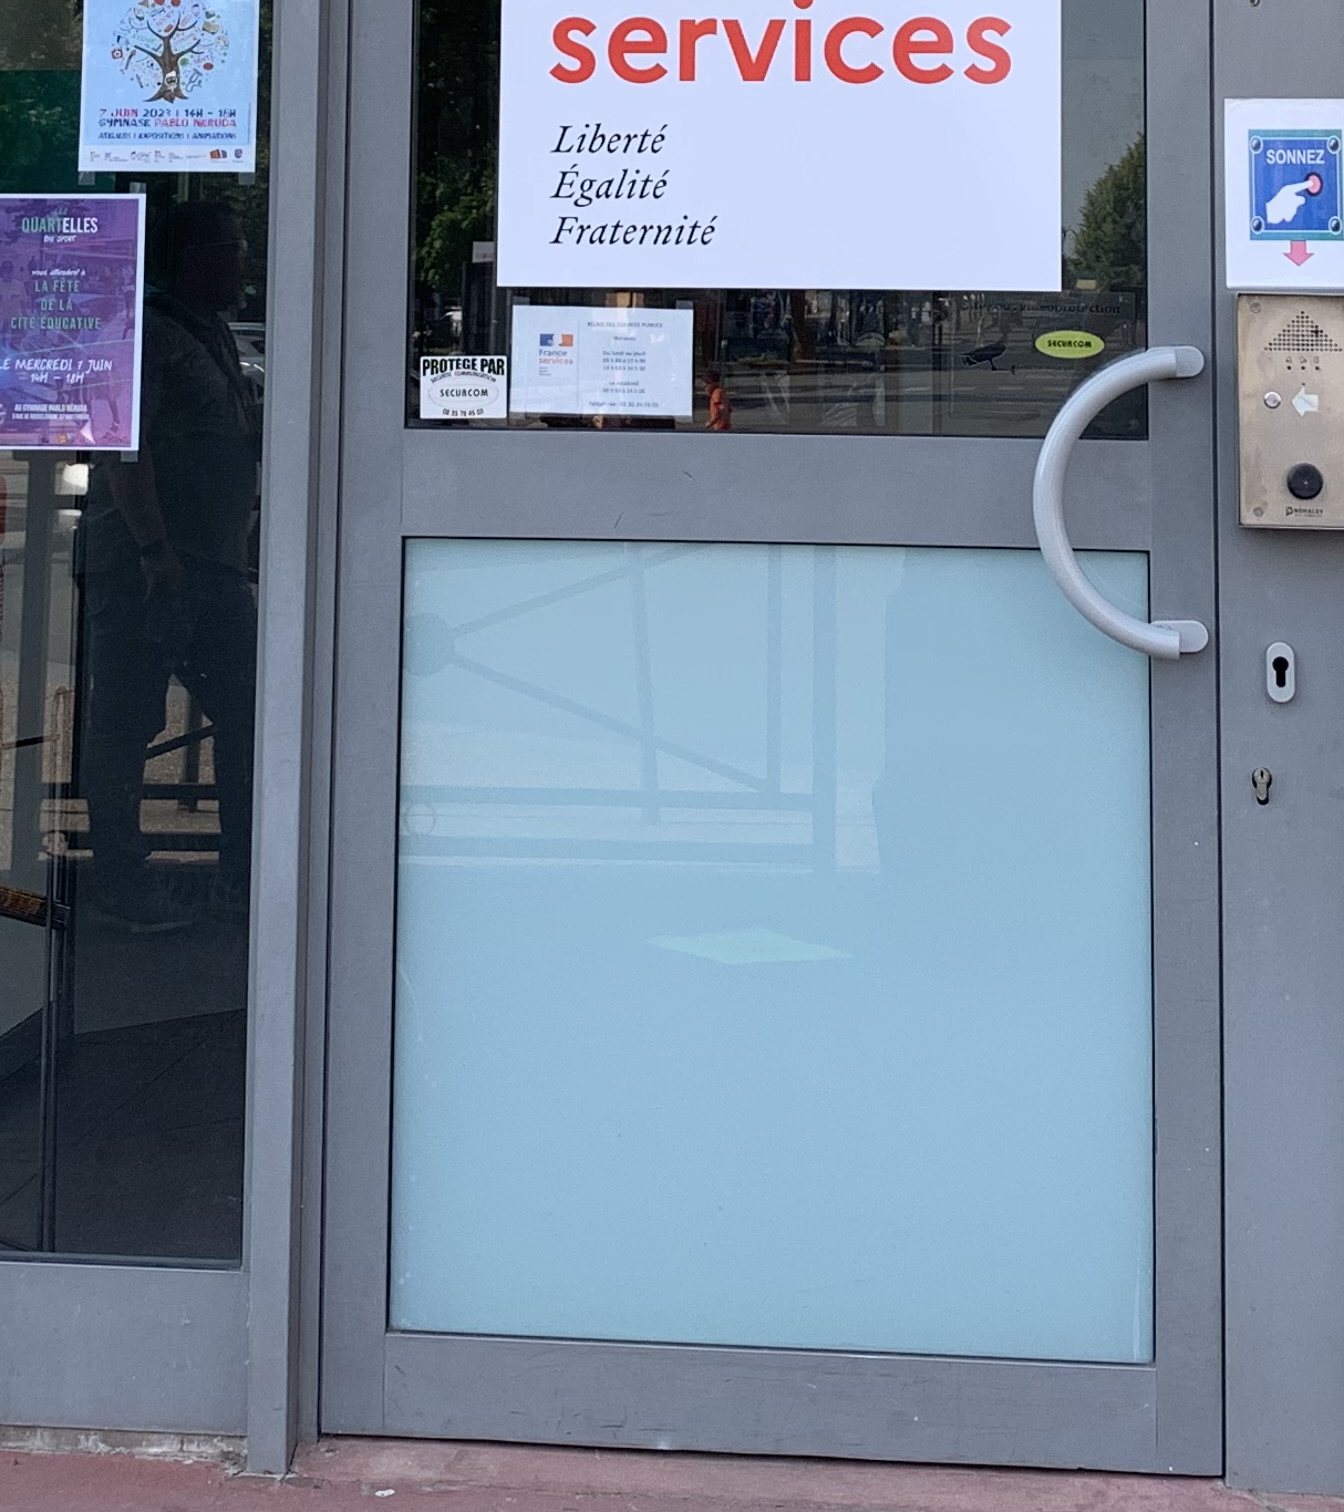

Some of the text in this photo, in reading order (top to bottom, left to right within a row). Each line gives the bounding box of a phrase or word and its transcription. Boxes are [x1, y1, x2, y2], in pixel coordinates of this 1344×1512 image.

[99, 119, 150, 127] GYMNASE
[155, 119, 188, 127] PABLO
[550, 124, 667, 154] Liberté
[1266, 149, 1325, 165] SONNEZ
[550, 164, 670, 207] Égalité
[22, 217, 98, 233] QUARTELLES
[549, 214, 716, 246] Fraternité
[35, 280, 49, 292] LA
[41, 299, 54, 311] DE
[1047, 339, 1092, 348] SECURCOM
[15, 358, 72, 370] MERCREDI
[85, 359, 112, 374] JUIN
[481, 358, 504, 376] PAR
[539, 356, 573, 365] services
[440, 388, 488, 397] SECURCOM
